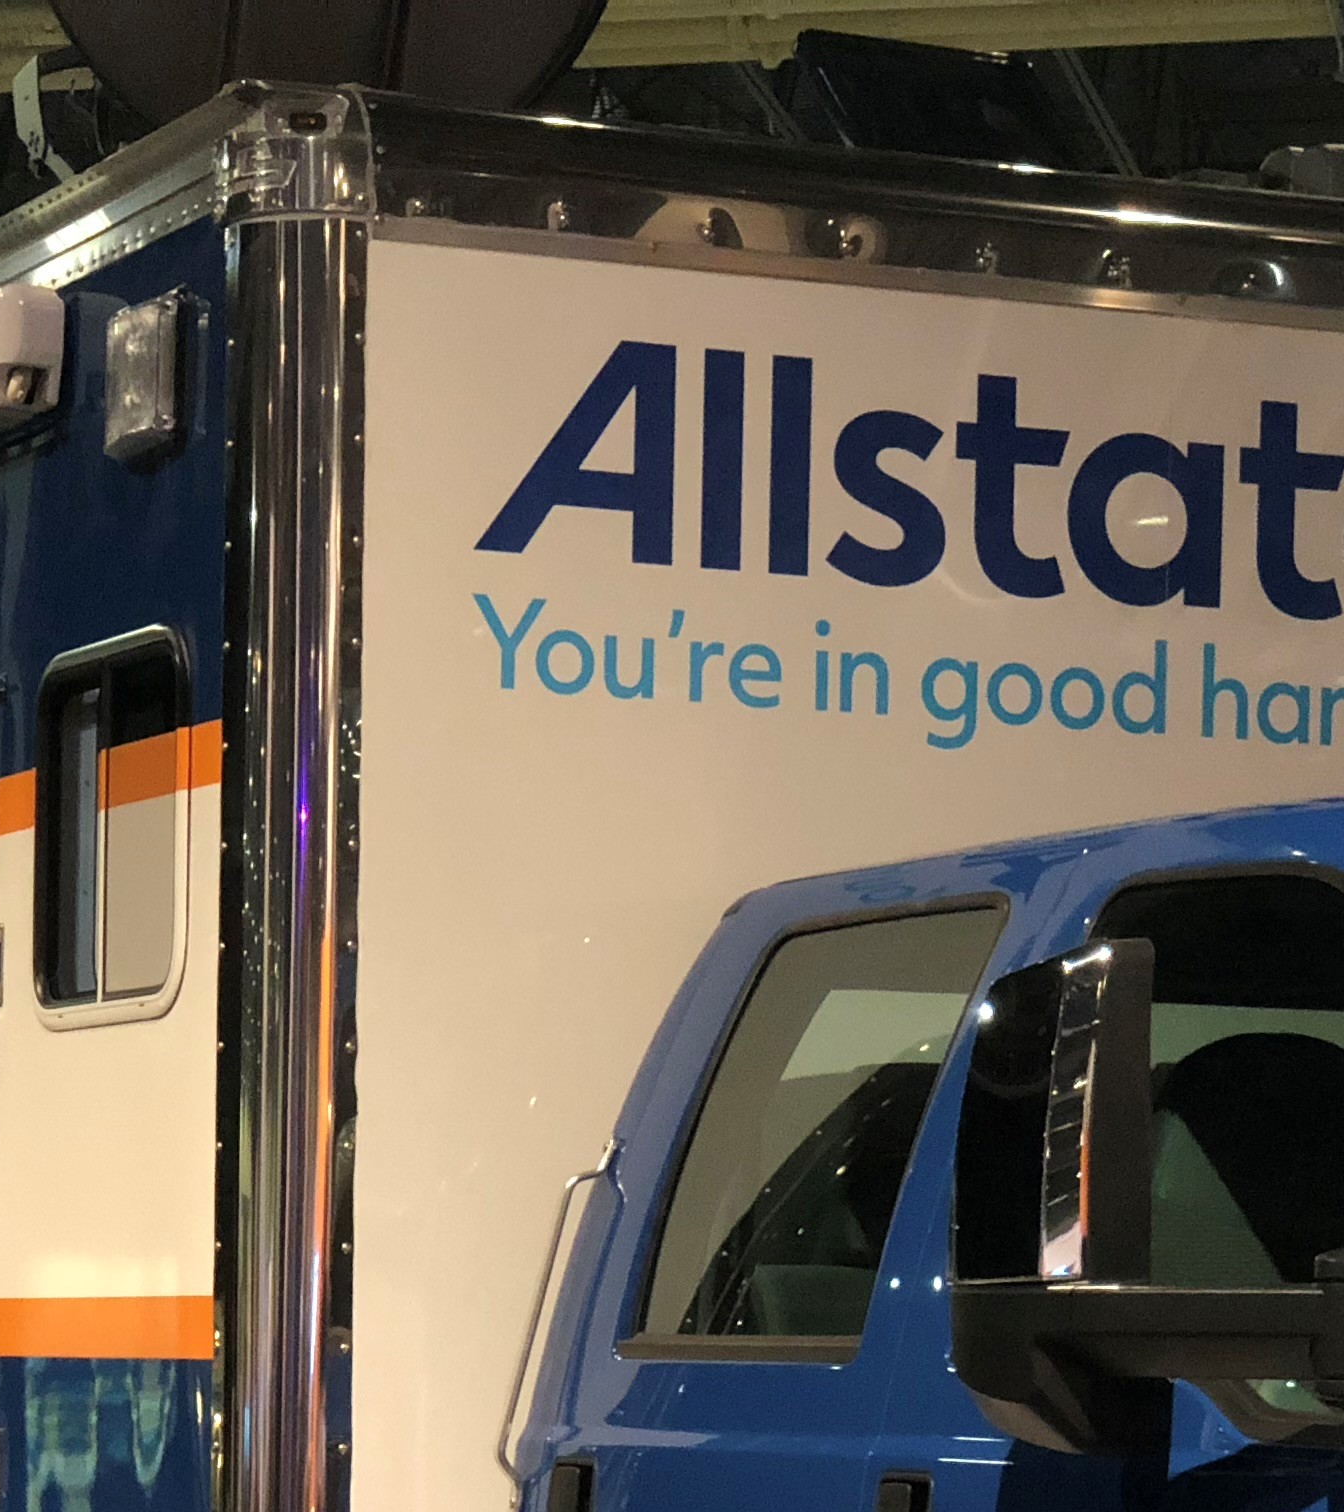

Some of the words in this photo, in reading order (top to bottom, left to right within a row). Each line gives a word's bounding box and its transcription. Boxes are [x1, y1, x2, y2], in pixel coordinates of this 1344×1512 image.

[472, 592, 782, 709] You're
[814, 619, 888, 715] in
[921, 639, 1167, 751] good
